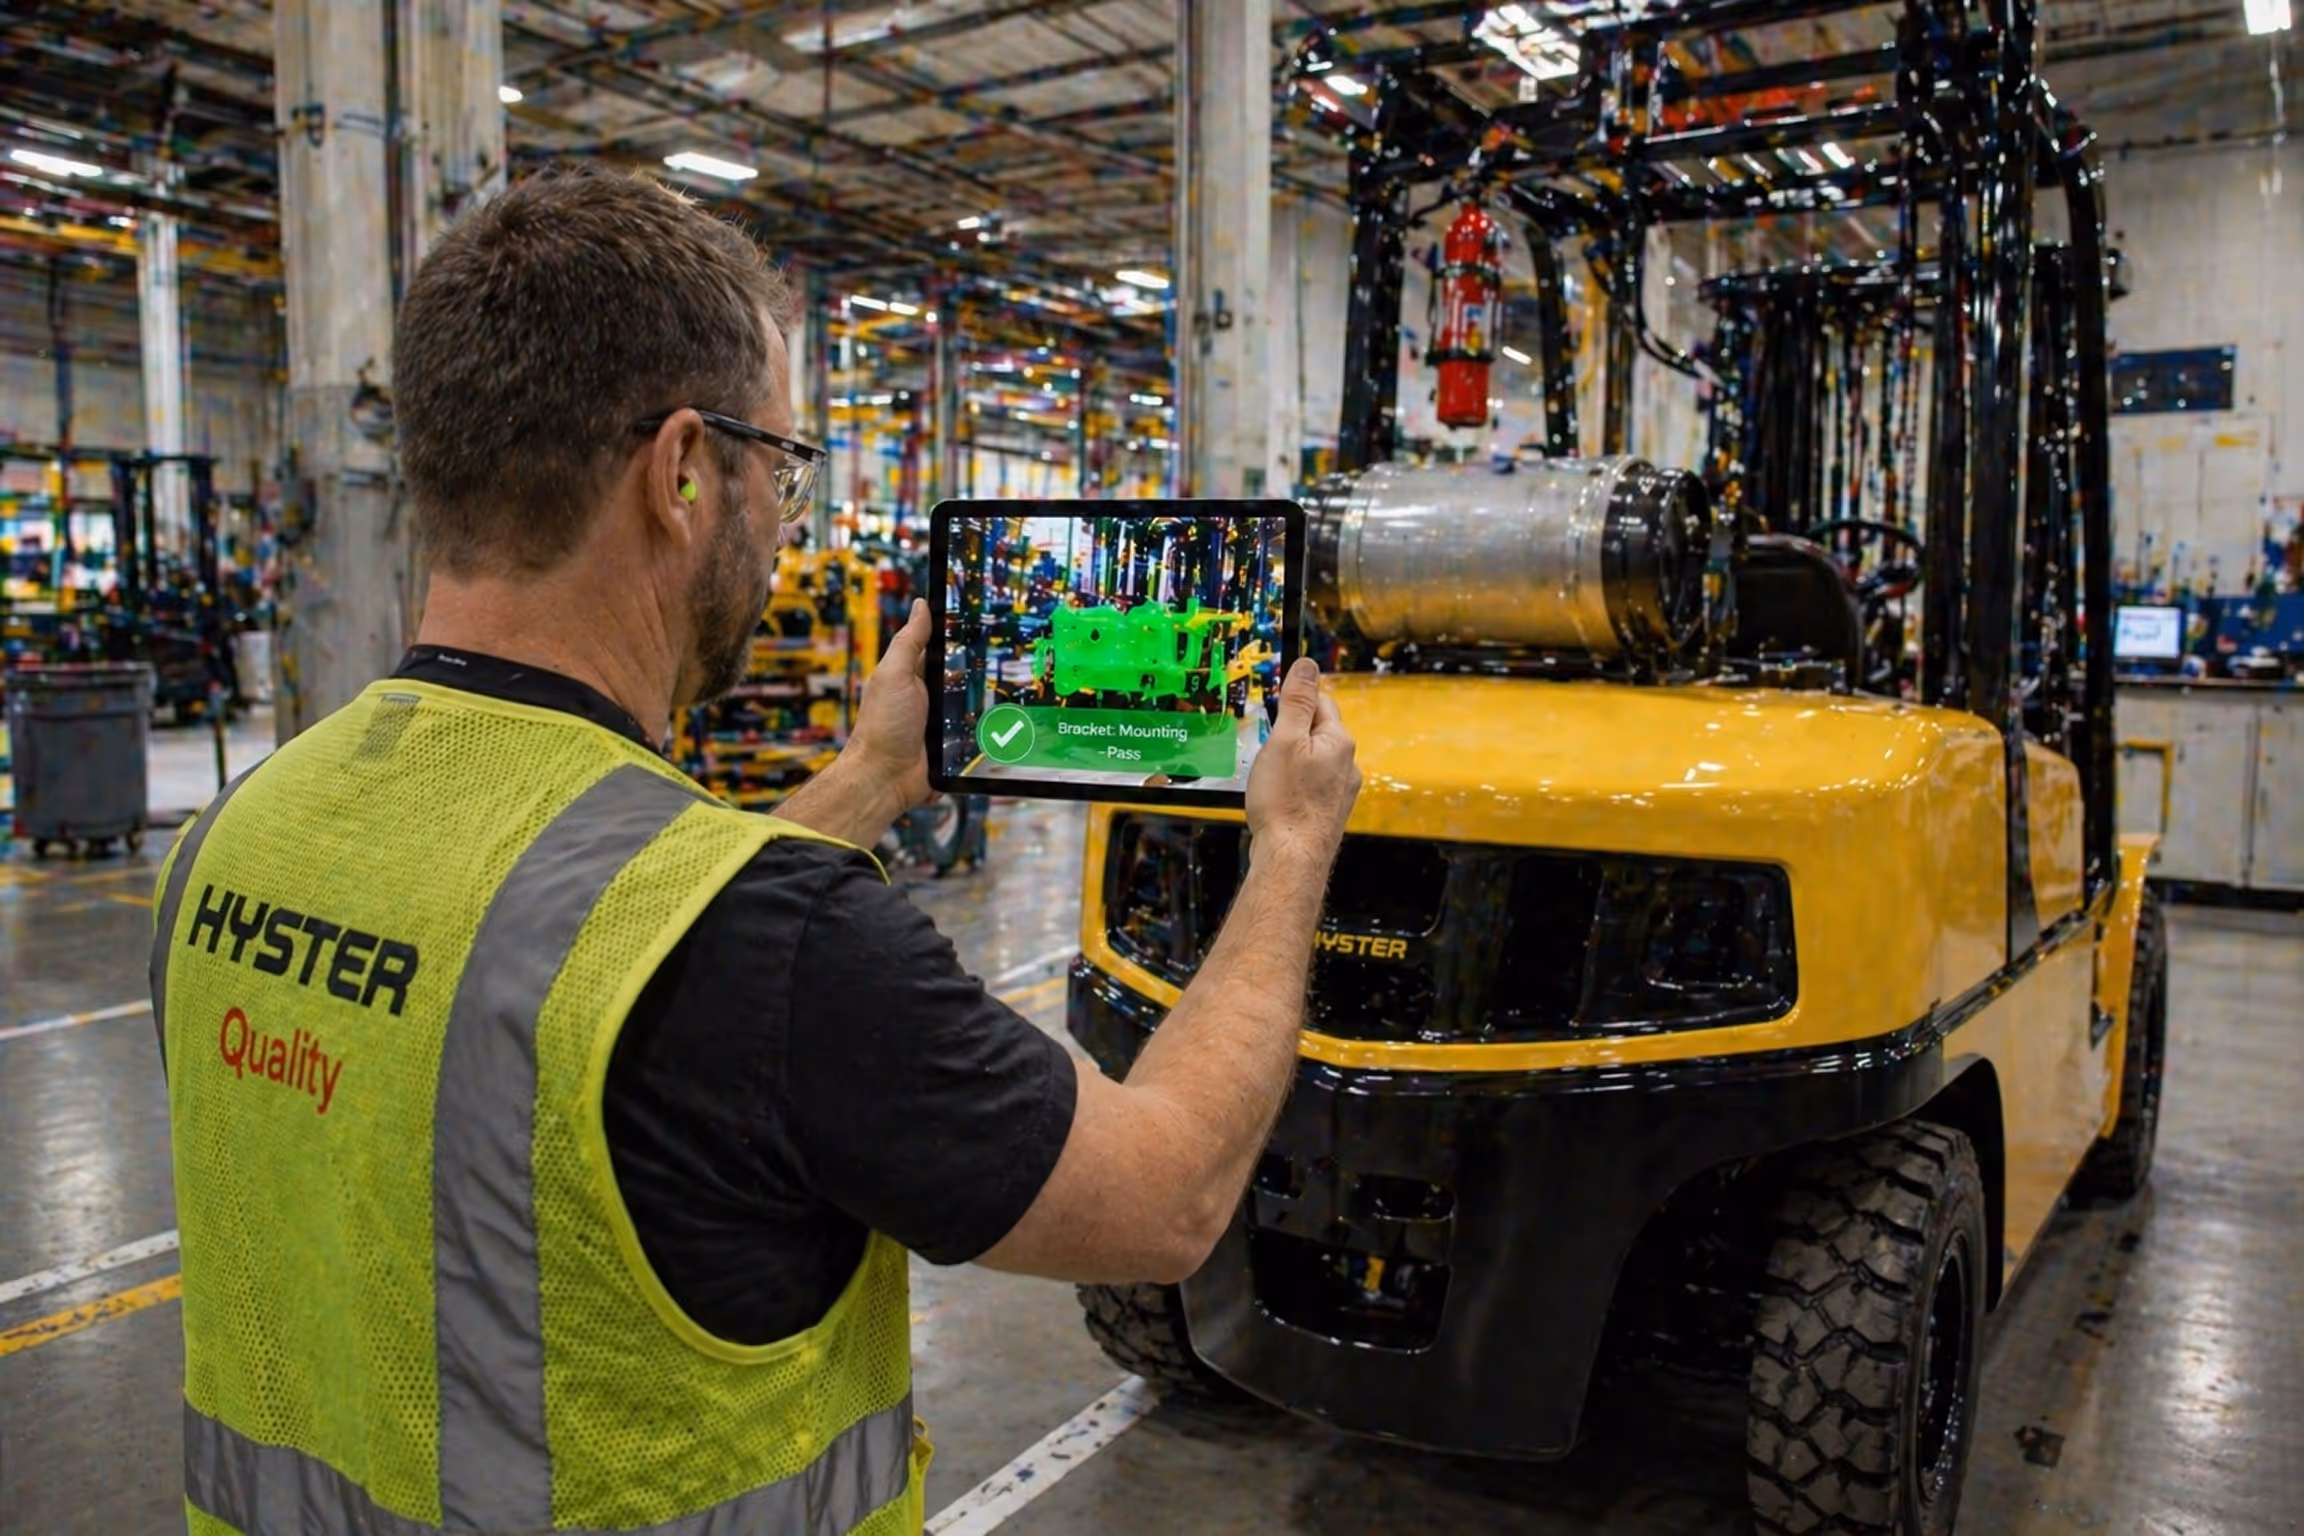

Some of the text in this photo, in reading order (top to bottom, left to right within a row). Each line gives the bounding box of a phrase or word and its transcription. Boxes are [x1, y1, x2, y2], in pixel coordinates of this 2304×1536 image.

[1119, 724, 1188, 742] Mounting
[188, 884, 418, 1016] HYSTER
[220, 1007, 342, 1114] Quality
